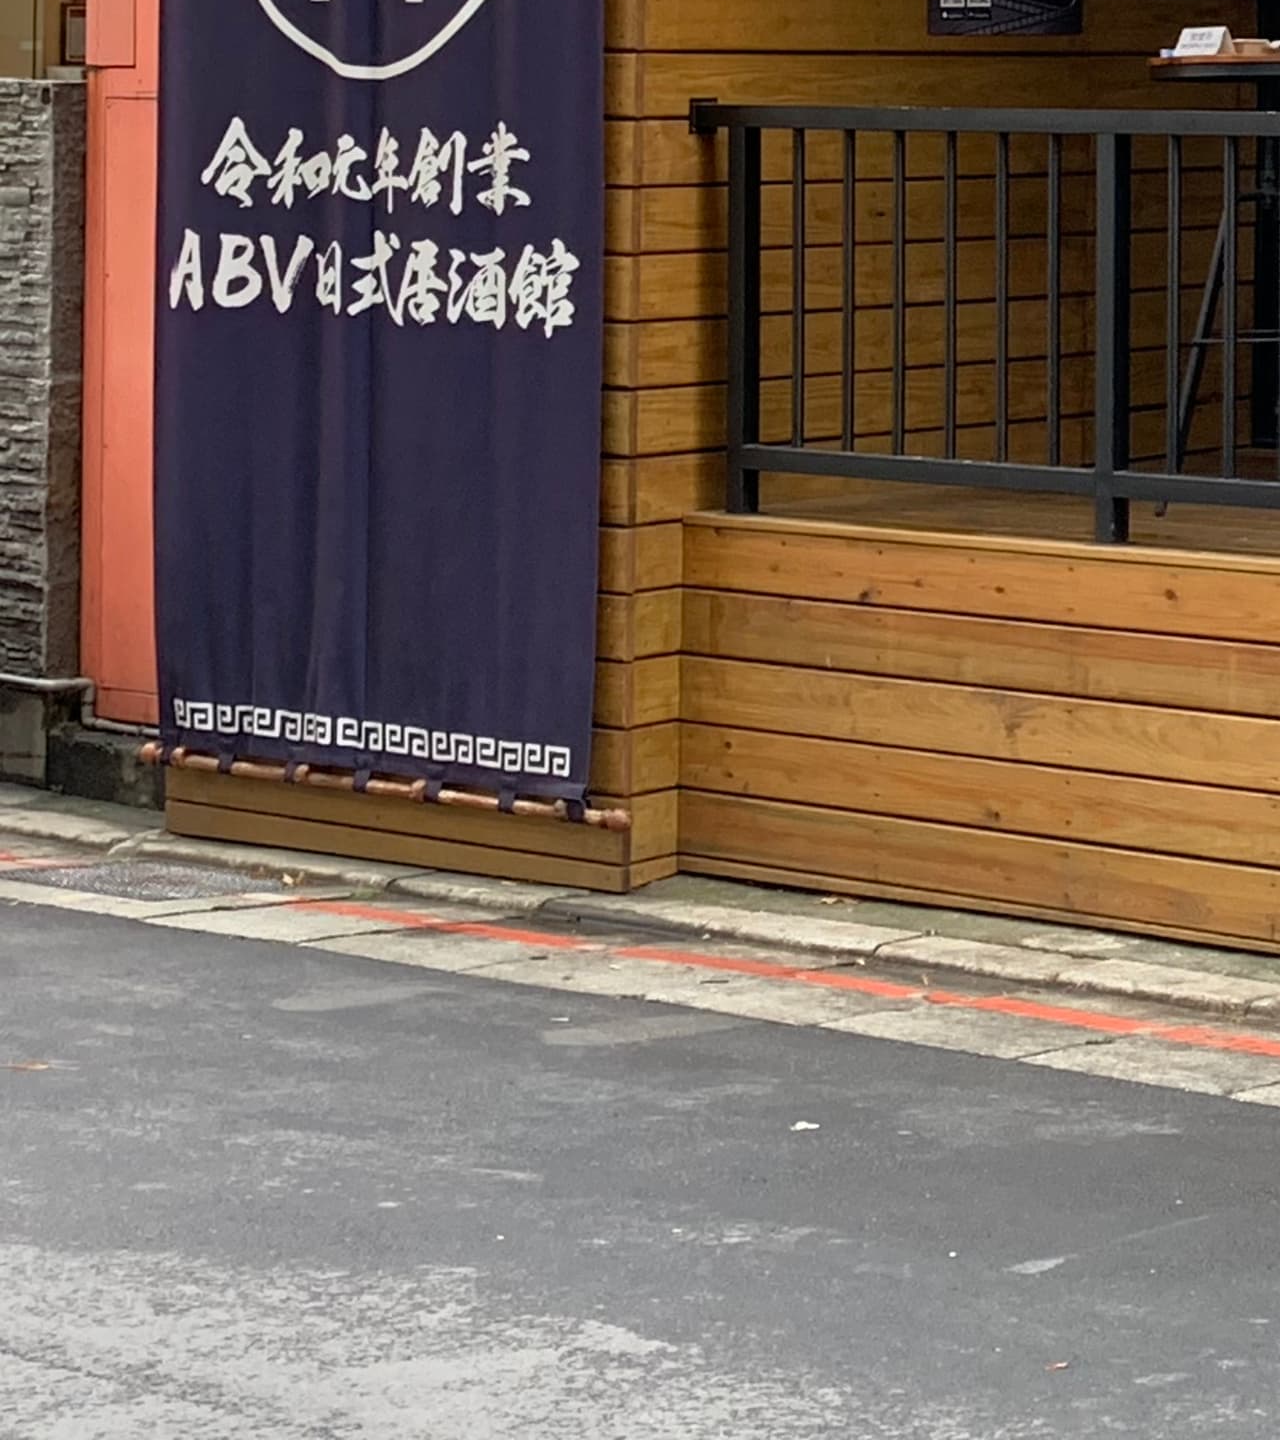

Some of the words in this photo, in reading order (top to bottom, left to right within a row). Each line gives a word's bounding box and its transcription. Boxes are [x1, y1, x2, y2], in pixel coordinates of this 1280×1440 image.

[201, 116, 532, 216] 令和元年創業
[169, 228, 581, 339] ABV日式居酒館
